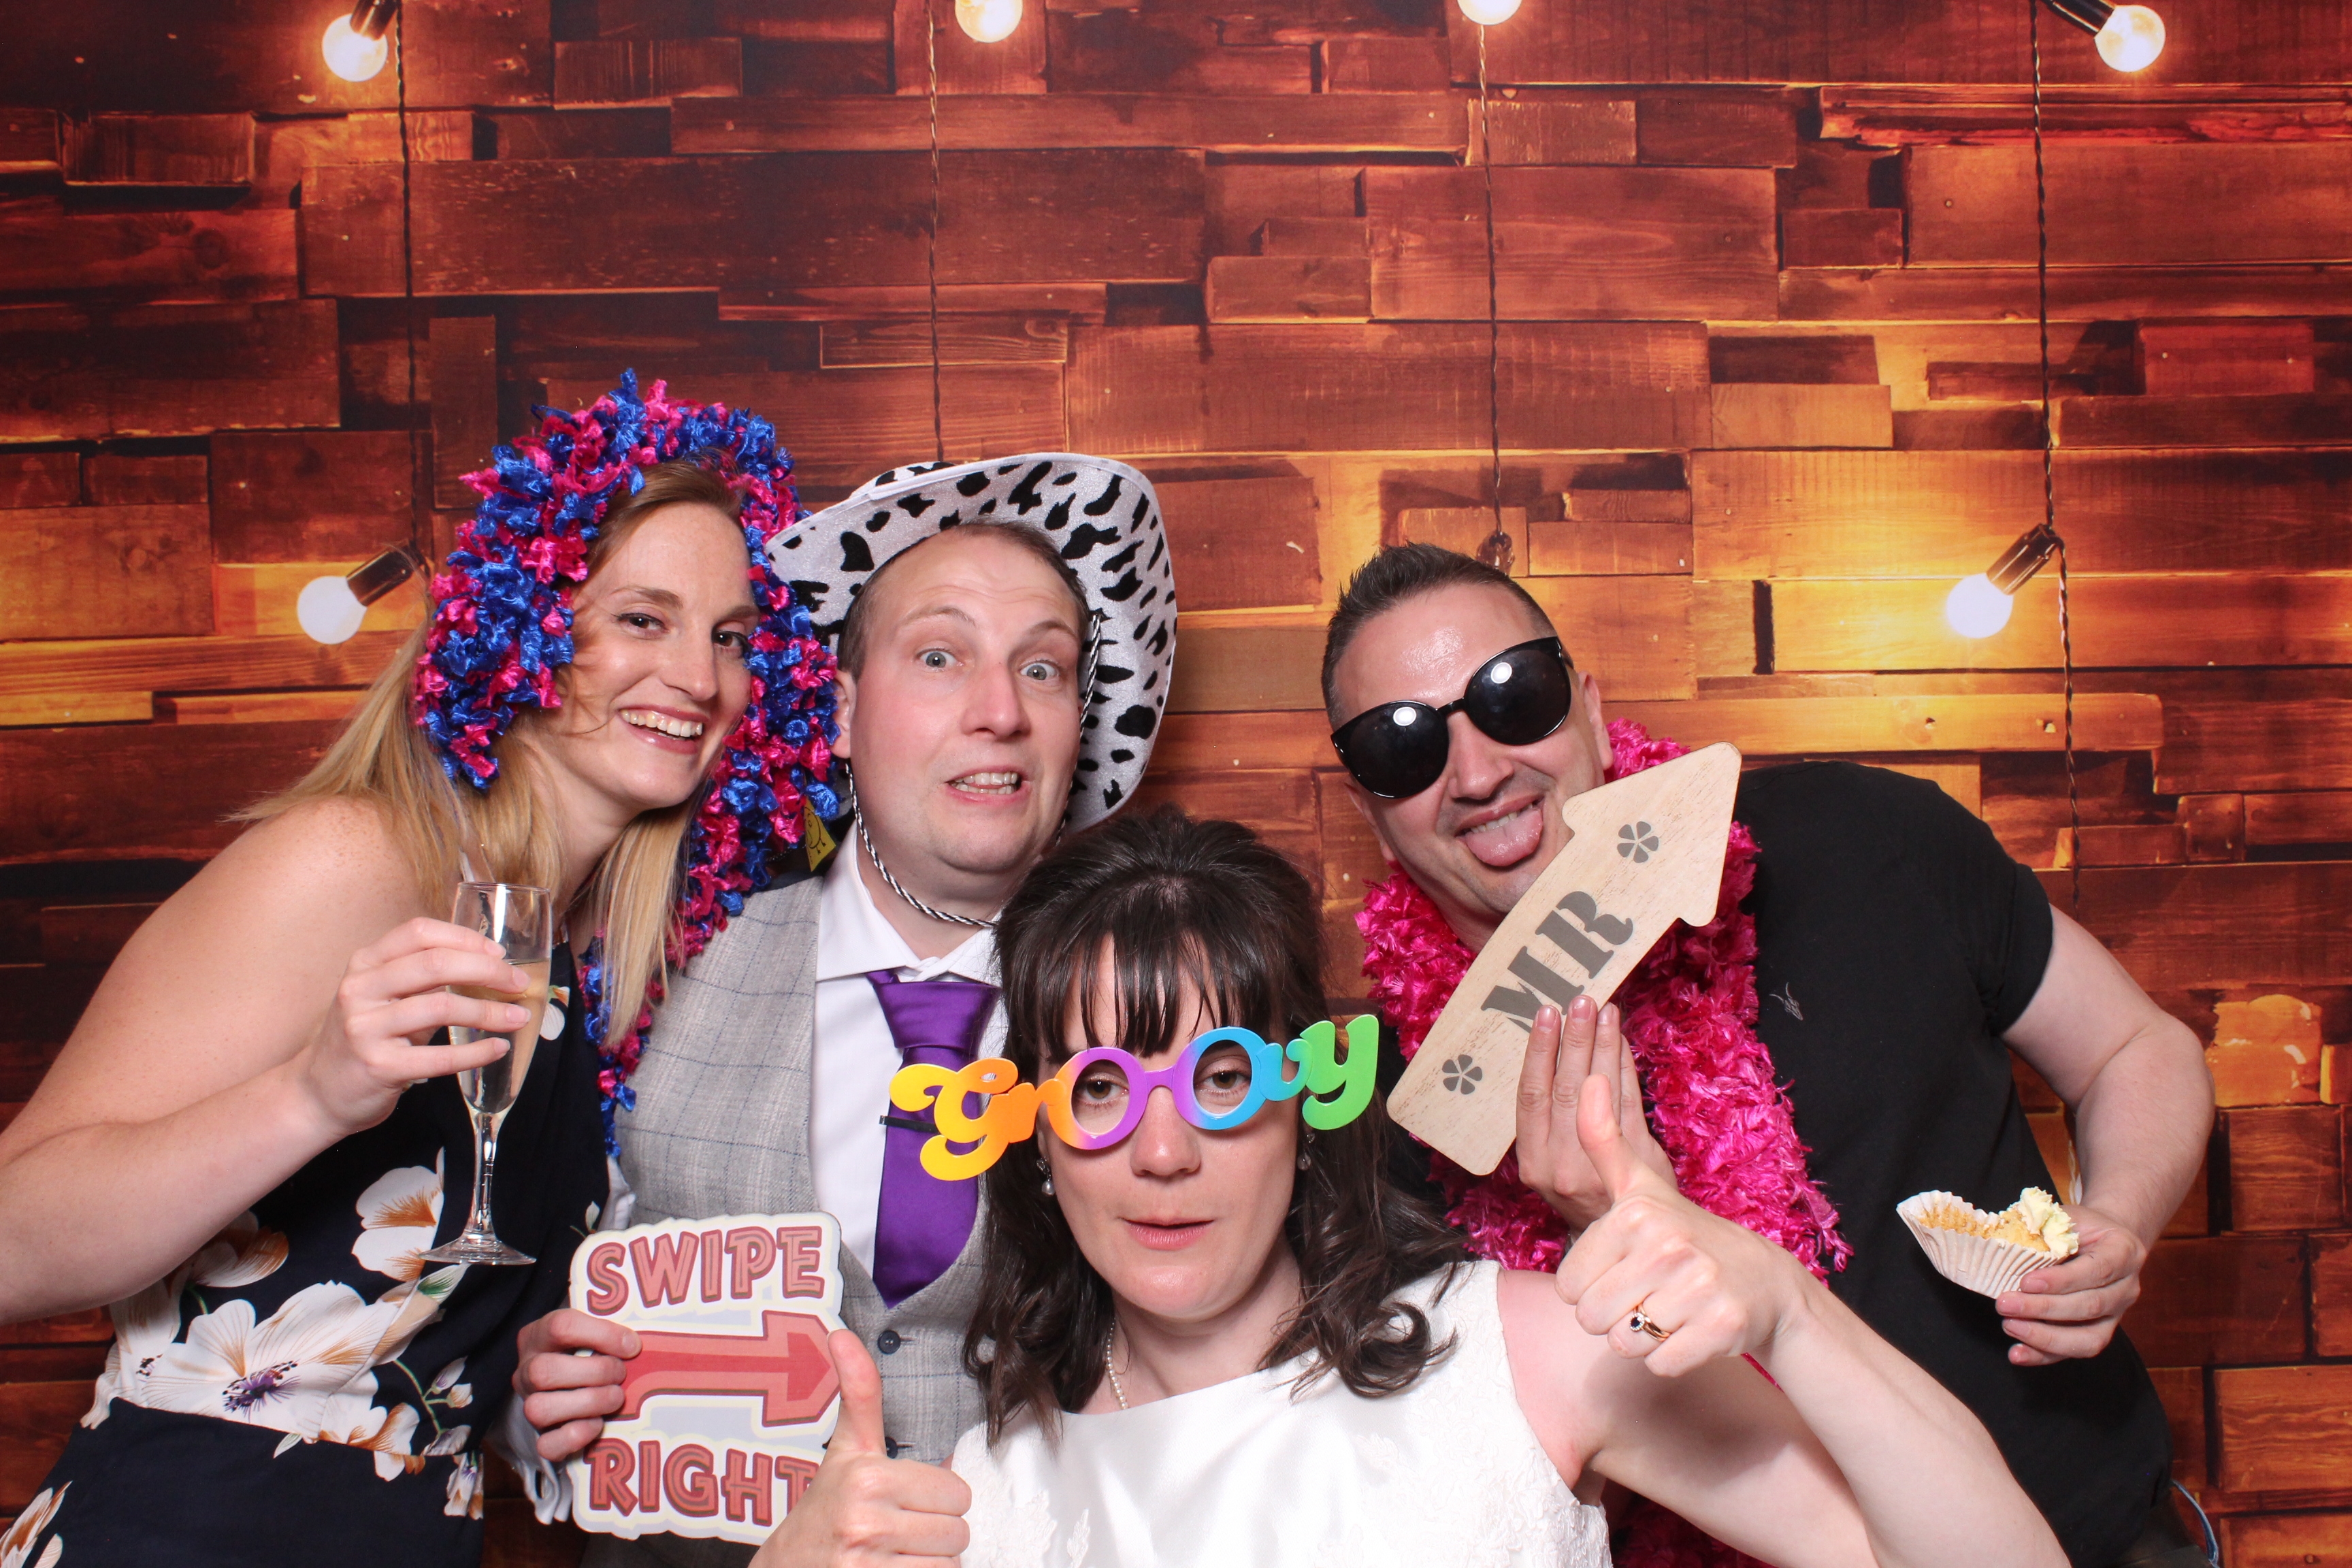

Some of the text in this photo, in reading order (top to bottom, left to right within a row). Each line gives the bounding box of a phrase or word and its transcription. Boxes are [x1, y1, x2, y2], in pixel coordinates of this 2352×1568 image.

[1481, 891, 1633, 1034] MR
[586, 1226, 825, 1316] SWIPE
[584, 1437, 820, 1527] RIGHT
